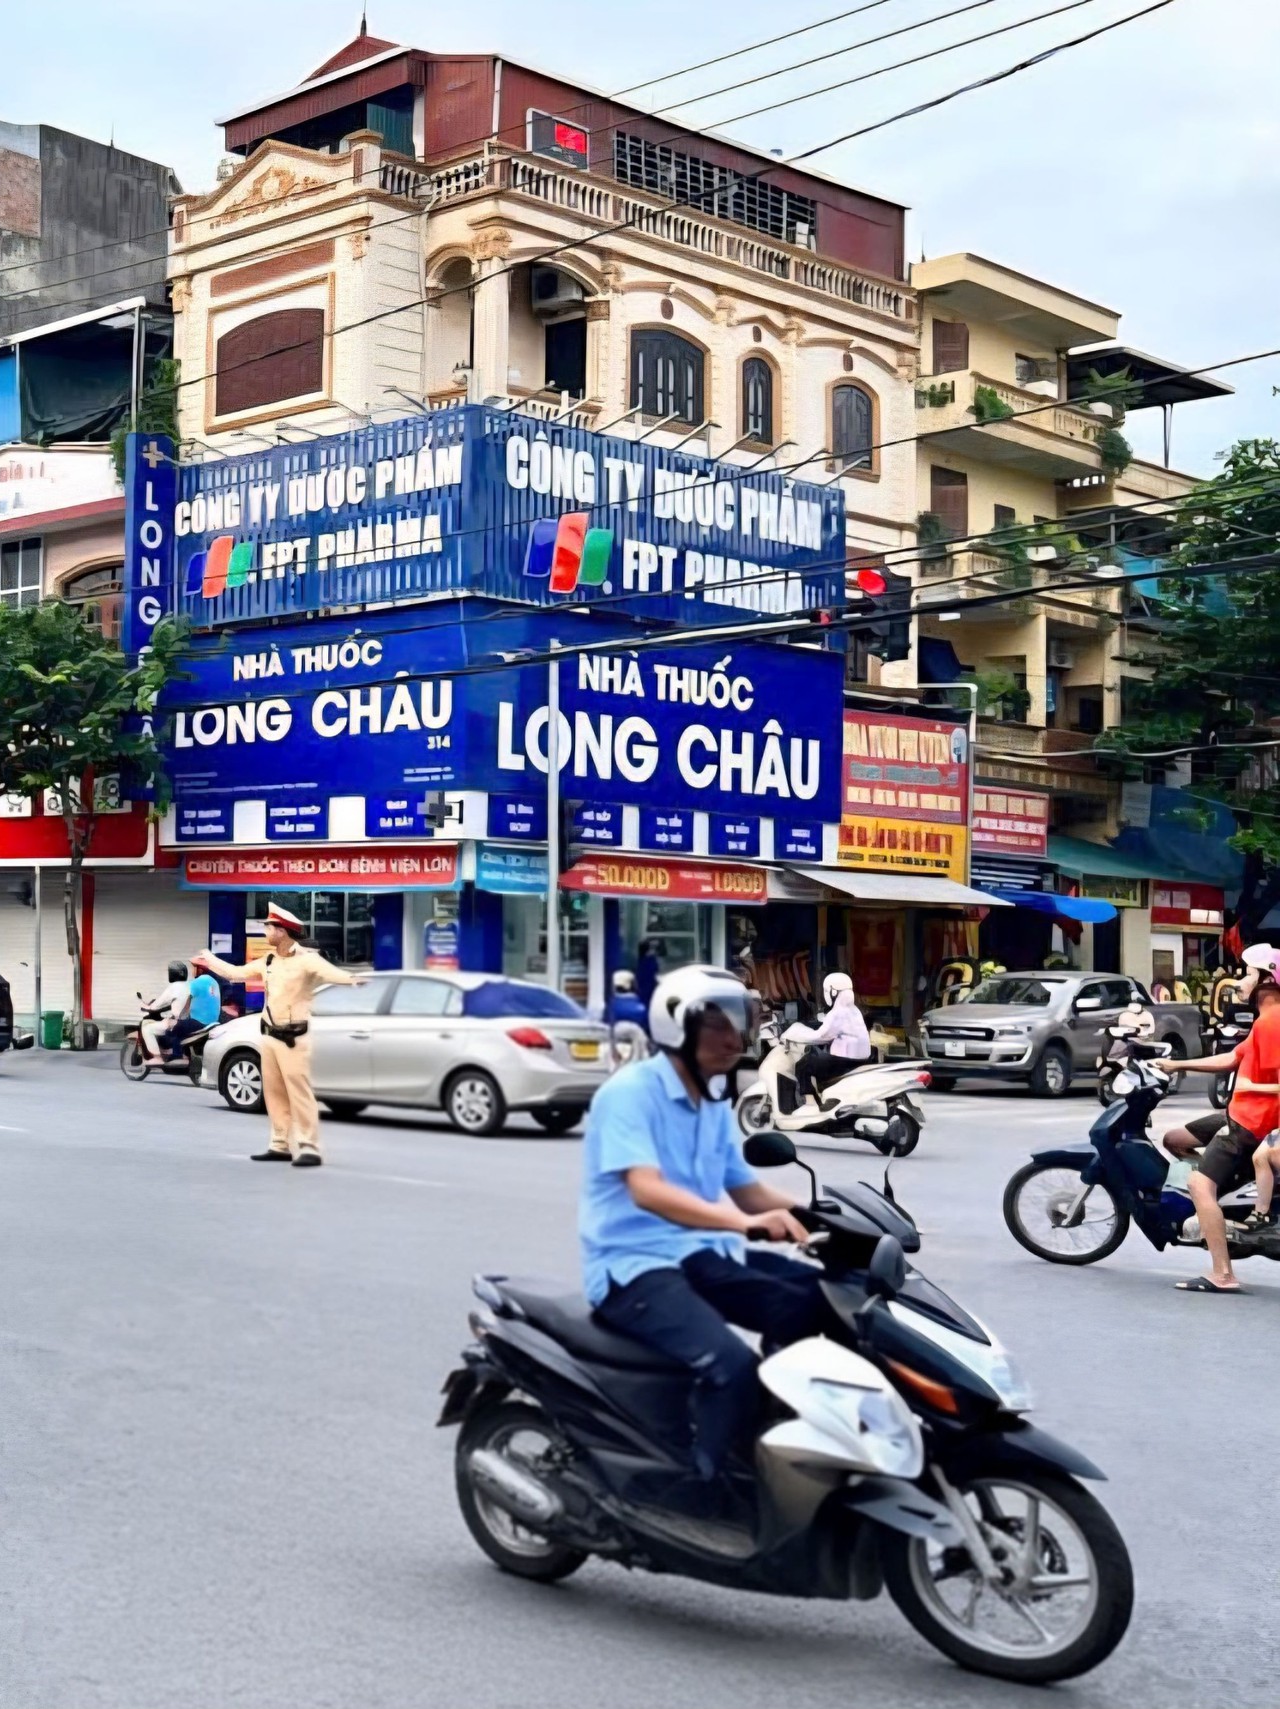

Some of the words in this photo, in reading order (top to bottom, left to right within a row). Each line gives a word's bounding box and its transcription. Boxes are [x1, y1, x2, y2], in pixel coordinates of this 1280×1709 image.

[506, 430, 595, 504] CÔNG
[604, 456, 644, 512] TY
[175, 490, 240, 537] CÔNG
[248, 482, 280, 523] TY
[138, 481, 163, 625] LONG
[262, 537, 310, 581] FPT
[318, 514, 442, 571] PHARMA
[623, 539, 677, 592] FPT
[233, 643, 284, 681] NHÀ
[290, 629, 383, 675] THUỐC
[578, 650, 645, 697] NHÀ
[654, 655, 754, 712] THUỐC
[175, 698, 292, 748] LONG
[311, 671, 453, 738] CHÂU
[497, 701, 659, 783] LONG
[677, 719, 820, 800] CHÂU
